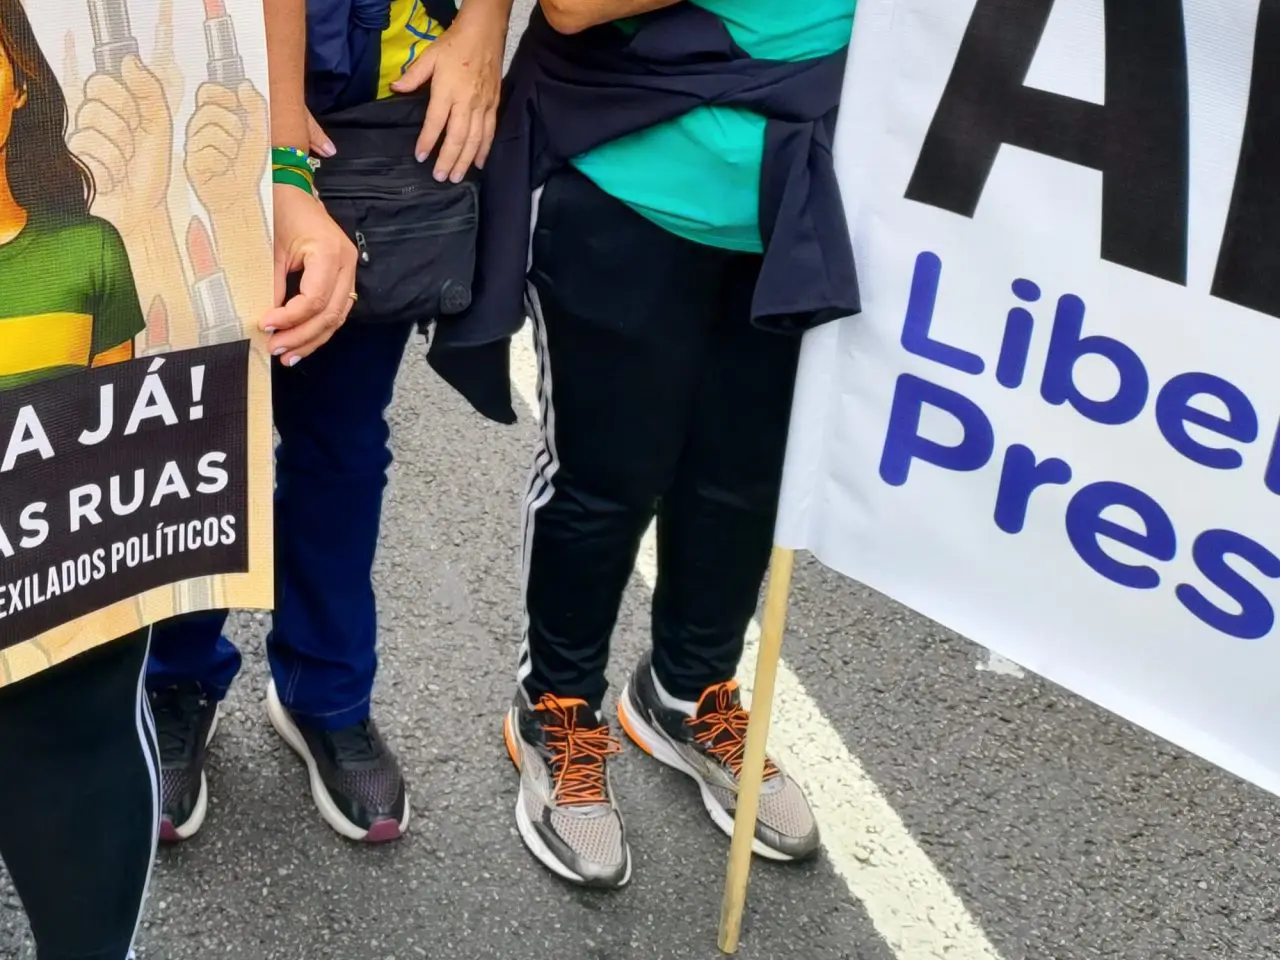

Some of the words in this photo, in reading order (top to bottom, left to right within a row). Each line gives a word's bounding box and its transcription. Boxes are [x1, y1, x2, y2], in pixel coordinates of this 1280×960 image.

[77, 358, 206, 446] JÁ!
[901, 251, 1280, 496] Libe
[69, 450, 230, 533] RUAS
[879, 373, 1280, 640] Pres
[111, 514, 236, 574] POLÍTICOS
